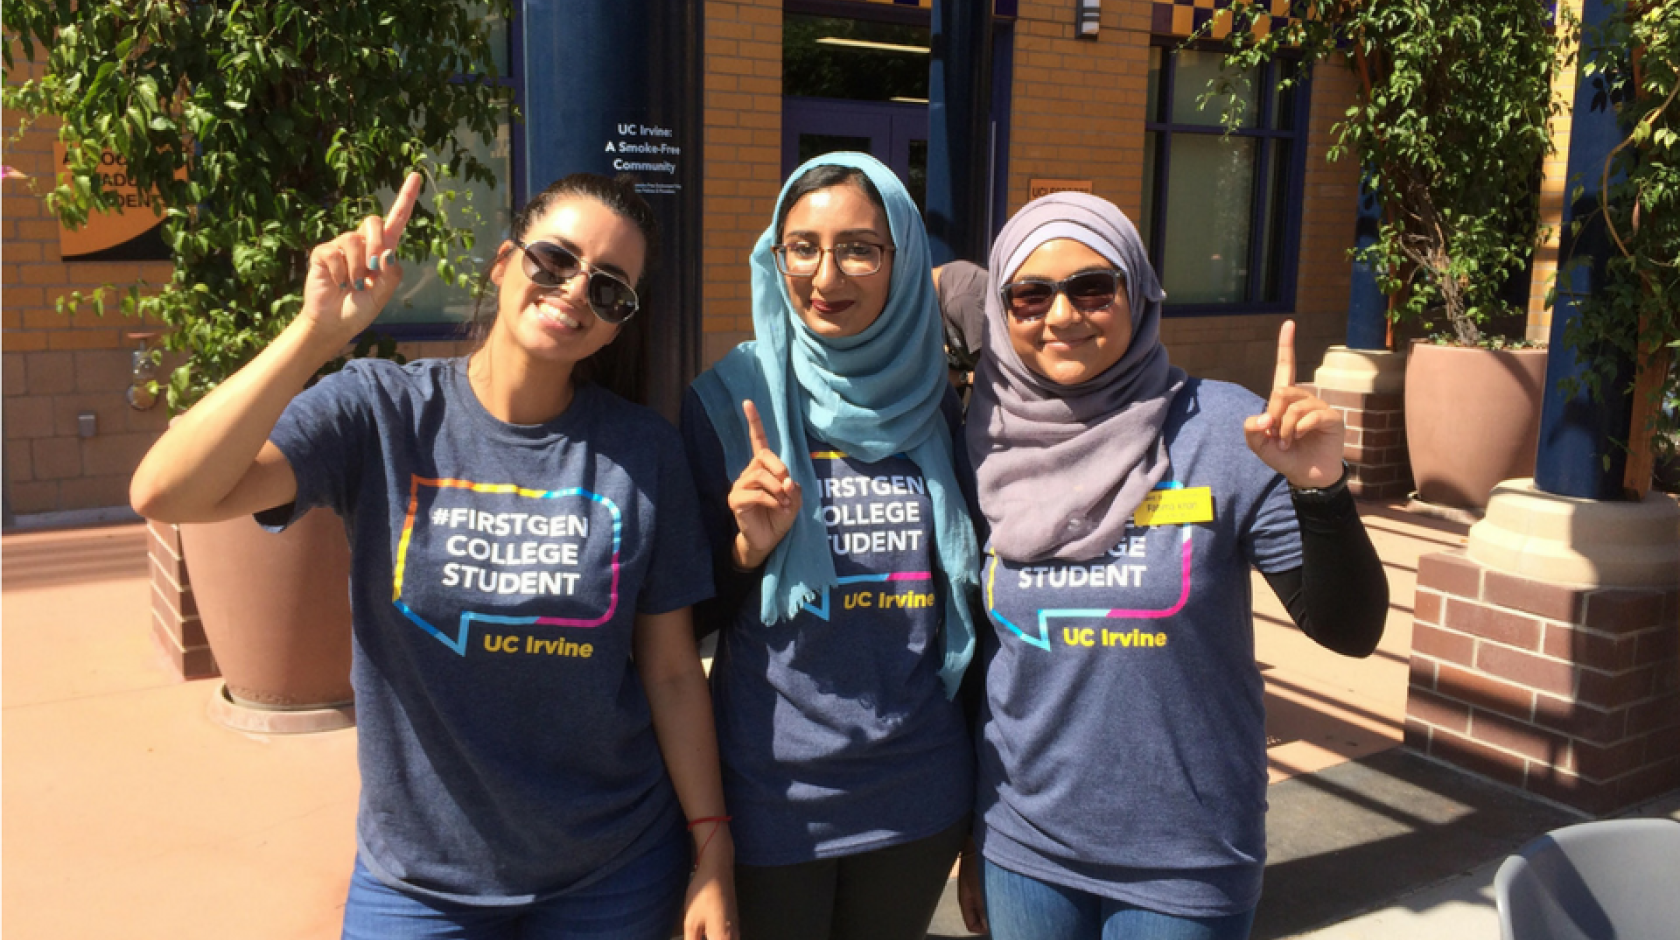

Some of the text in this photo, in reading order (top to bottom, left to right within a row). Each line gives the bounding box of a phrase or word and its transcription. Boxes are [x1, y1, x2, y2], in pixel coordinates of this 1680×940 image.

[617, 123, 637, 136] UC
[605, 140, 681, 155] A Smoke-Free
[613, 158, 676, 175] Community
[817, 476, 925, 498] IRSTGEN
[432, 508, 588, 538] #FIRSTGEN
[821, 501, 920, 527] OLLEGE
[446, 535, 578, 565] COLLEGE
[828, 530, 922, 555] UDENT
[441, 562, 581, 595] STUDENT
[1018, 564, 1147, 588] STUDENT
[844, 590, 935, 610] UC Irvine
[483, 634, 594, 658] UC Irvine
[1063, 627, 1168, 647] UC Irvine
